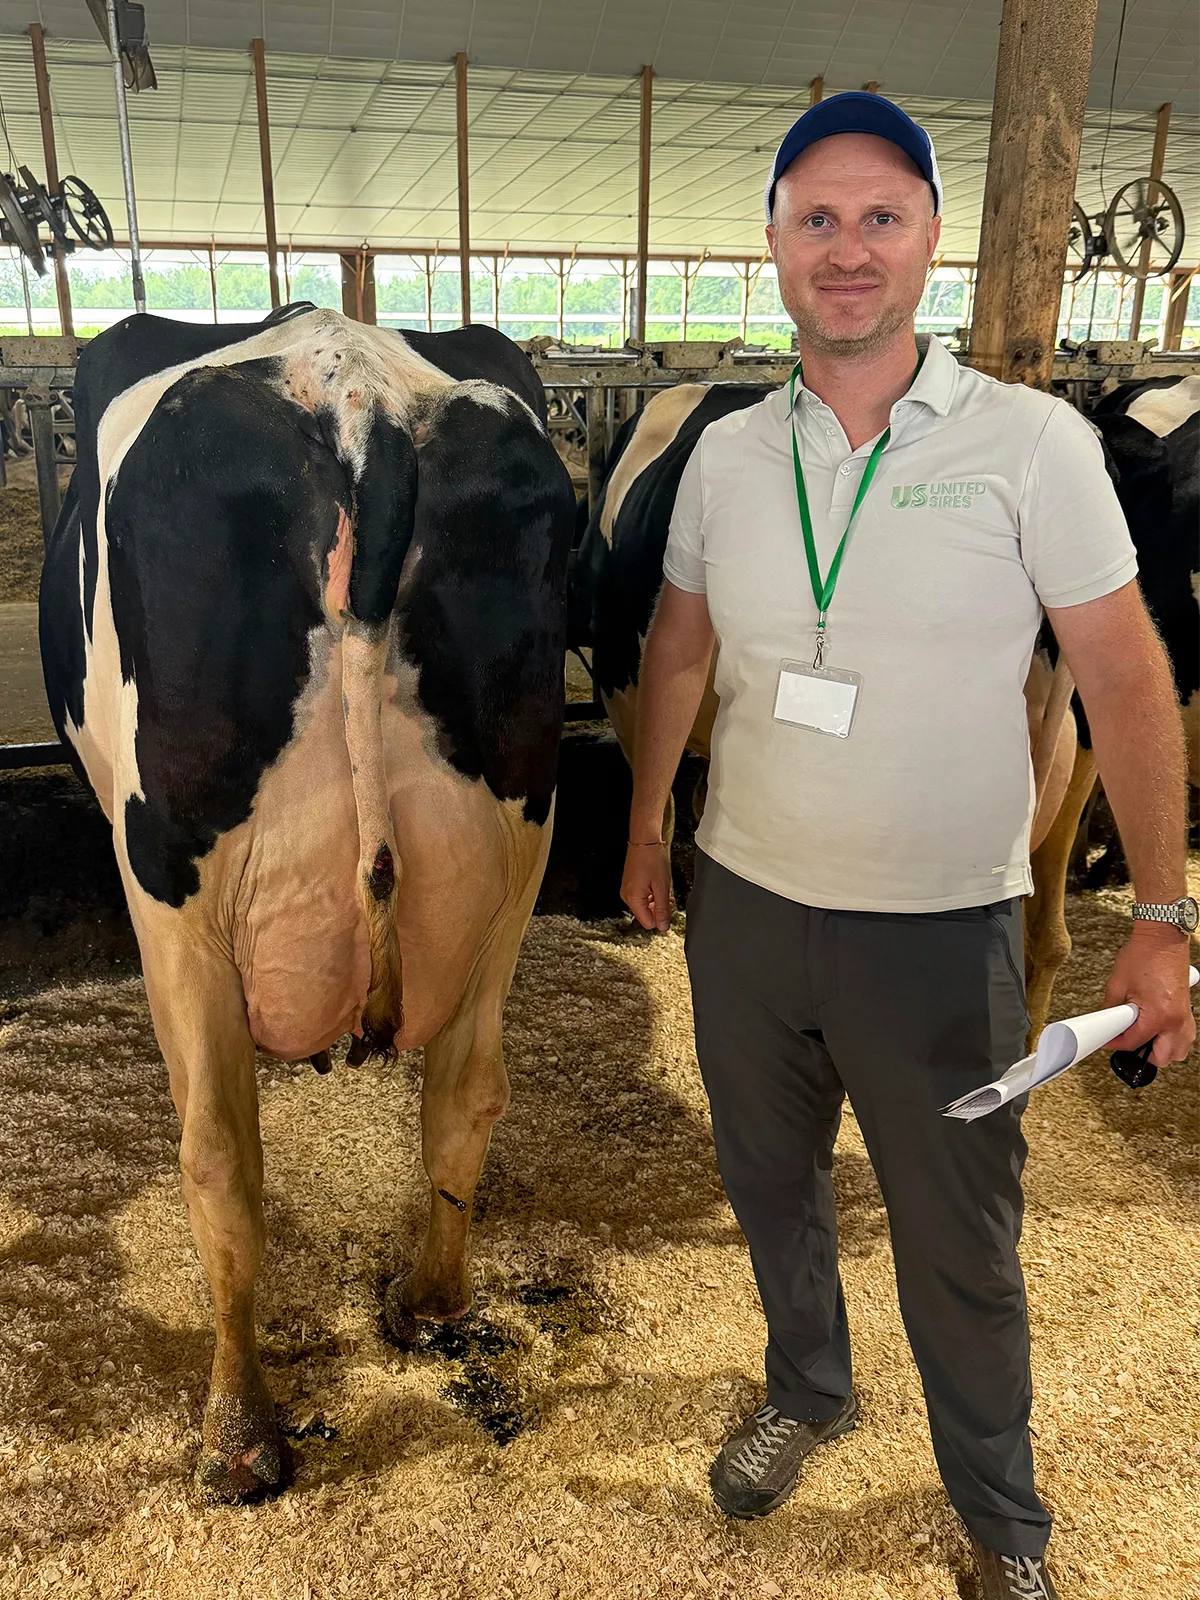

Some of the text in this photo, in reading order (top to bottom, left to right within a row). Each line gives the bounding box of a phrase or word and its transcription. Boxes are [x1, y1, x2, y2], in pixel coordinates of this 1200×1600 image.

[929, 482, 986, 495] UNITED
[891, 483, 927, 509] US
[929, 495, 972, 508] SIRES
